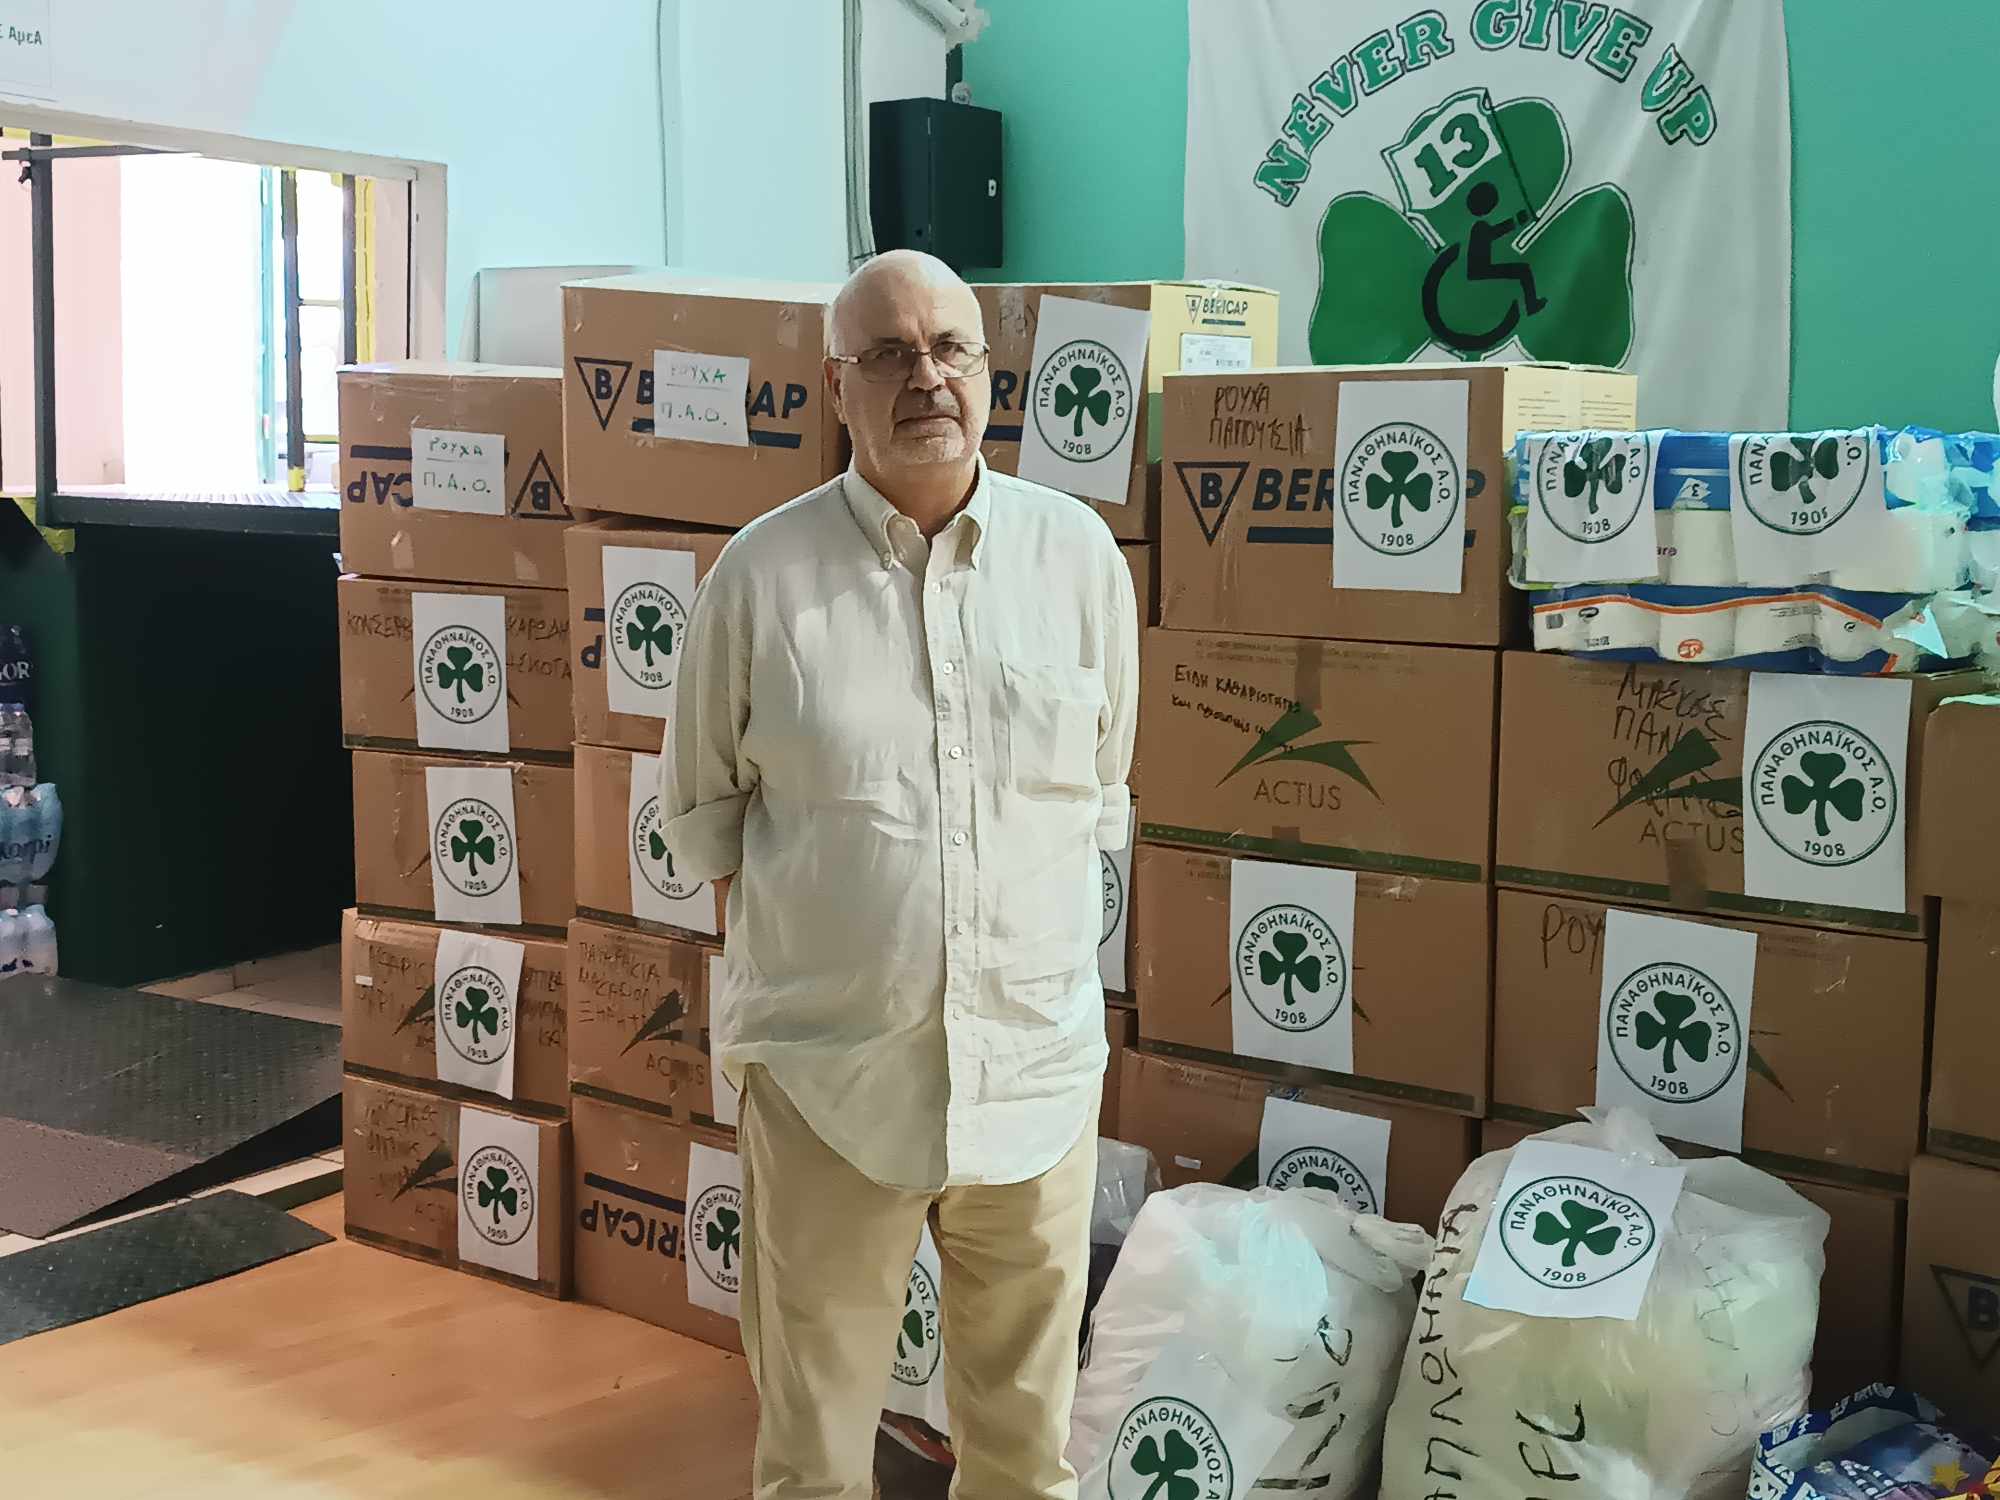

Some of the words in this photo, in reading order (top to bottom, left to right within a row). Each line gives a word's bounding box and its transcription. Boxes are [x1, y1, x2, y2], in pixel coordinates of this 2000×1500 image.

[1254, 10, 1454, 207] NEVER
[1471, 0, 1652, 82] GIVE
[1640, 44, 1717, 145] UP
[1414, 113, 1490, 197] 13
[595, 367, 613, 400] B
[1061, 439, 1092, 455] 1908
[1348, 429, 1444, 503] ΠΑΝΑΘΗΝΑΪΚΟΣ
[1437, 469, 1451, 504] Α.Ο.
[1200, 472, 1223, 509] B
[1380, 533, 1415, 548] 1908
[1761, 730, 1877, 806] ΠΑΝΑΘΗΝΑΪΚΟΣ
[1868, 775, 1887, 813] Α.Ο.
[1253, 778, 1342, 811] ACTUS
[1639, 819, 1745, 855] ACTUS
[1804, 840, 1846, 858] 1908
[1243, 912, 1331, 976] ΠΑΝΑΘΗΝΑΪΚΟΣ
[1325, 954, 1339, 987] Α.Ο.
[1274, 1008, 1308, 1025] 1908
[1615, 971, 1726, 1038] ΠΑΝΑΘΗΝΑΪΚΟΣ
[1715, 1021, 1732, 1057] Α.Ο.
[1650, 1075, 1689, 1095] 1908
[1274, 1154, 1364, 1196] ΝΑΘΗΝΑΪΚΟΣ
[1510, 1183, 1640, 1231] ΠΑΝΑΘΗΝΑΪΚΟΣ
[1623, 1223, 1644, 1249] Α.Ο.
[1542, 1267, 1587, 1283] 1908
[1122, 1407, 1224, 1484] ΠΑΝΑΘΗΝΑΪΚΟΣ
